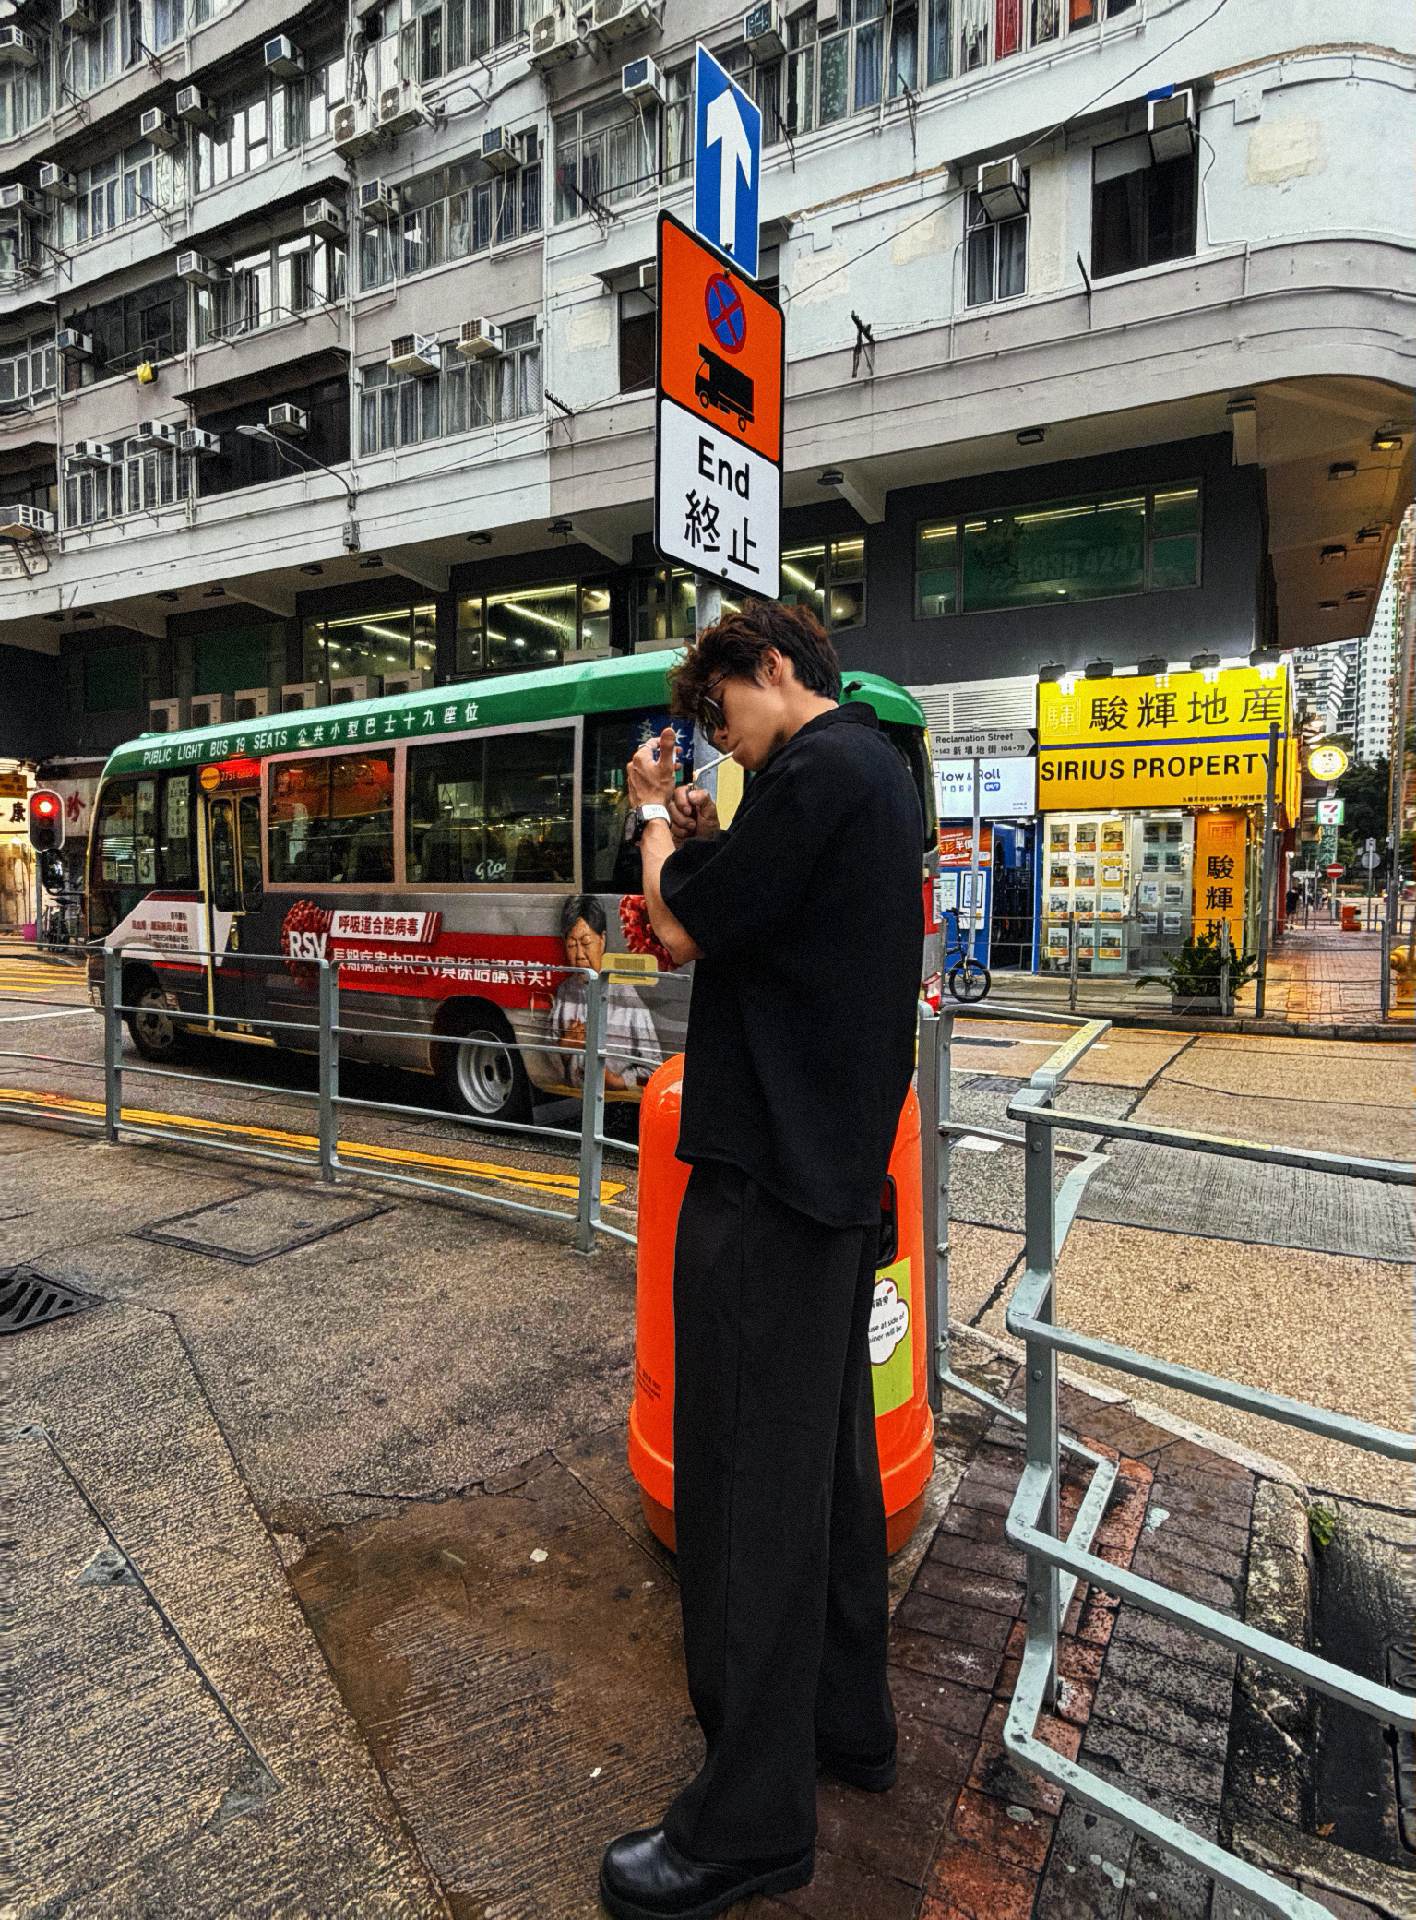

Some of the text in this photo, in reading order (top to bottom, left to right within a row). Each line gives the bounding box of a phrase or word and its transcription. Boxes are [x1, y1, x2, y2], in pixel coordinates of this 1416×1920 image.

[699, 435, 749, 500] End
[684, 489, 760, 574] 終止
[297, 702, 479, 745] 公共小型巴士十九座位
[935, 732, 1014, 744] Reclamation Street
[143, 730, 288, 766] PUBLIC LIGHT BUS 19 SEATS
[1041, 758, 1125, 781] SIRIUS
[338, 914, 419, 937] 呼吸道合胞病毒
[289, 931, 327, 960] RSV
